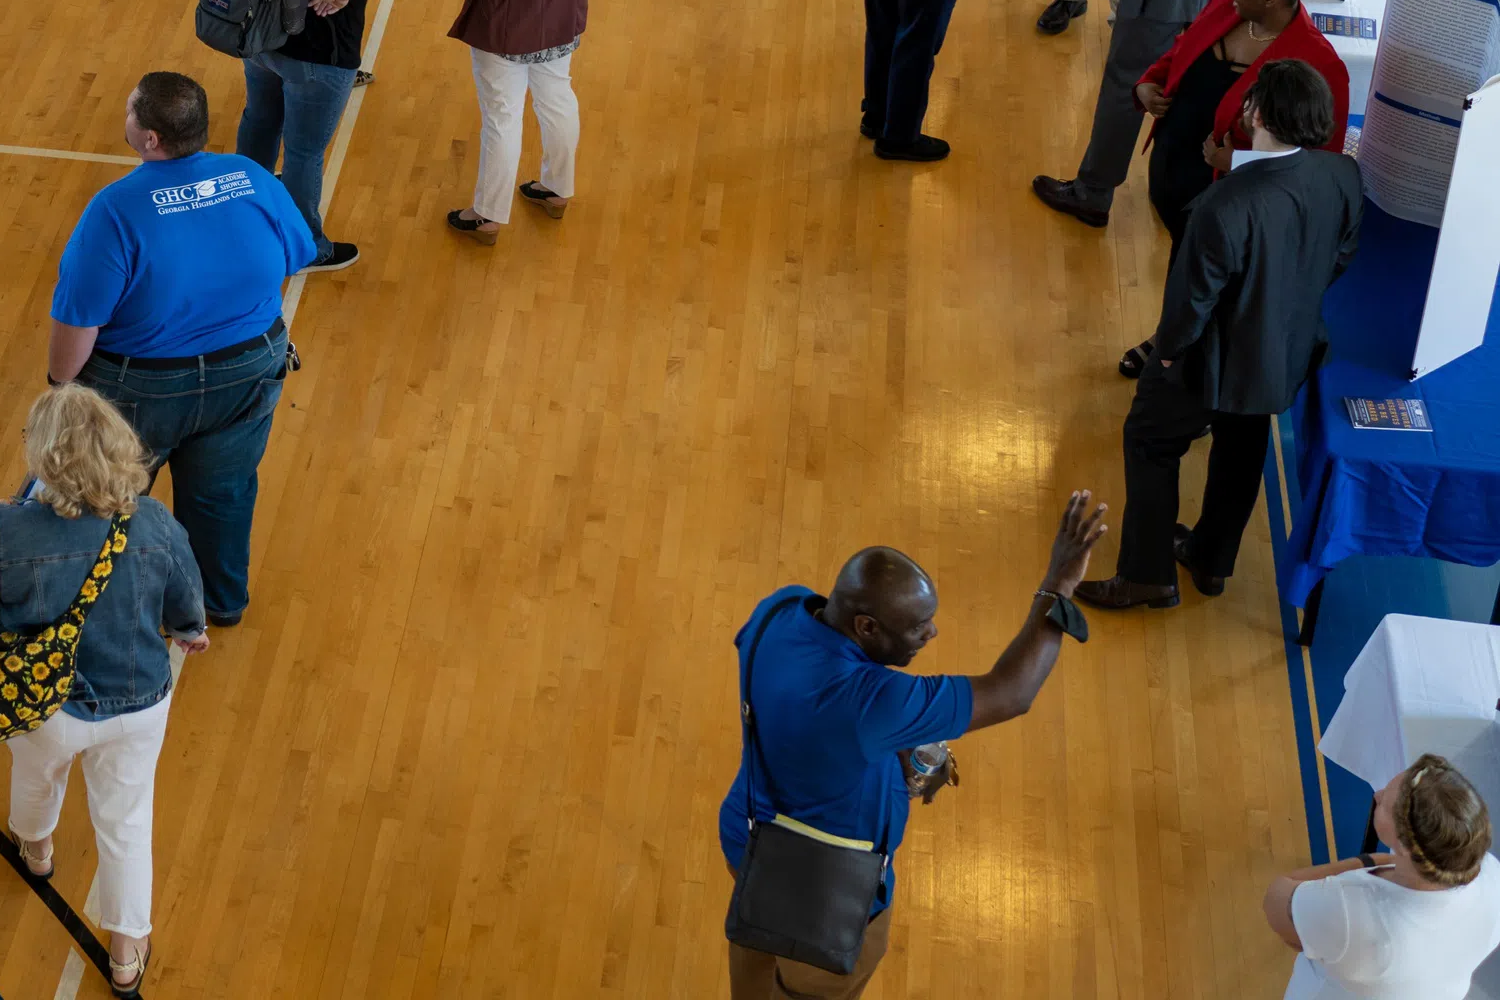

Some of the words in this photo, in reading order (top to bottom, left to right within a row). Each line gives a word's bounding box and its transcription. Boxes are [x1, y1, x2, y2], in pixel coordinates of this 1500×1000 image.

[218, 172, 248, 184] ACADEMIC
[220, 179, 251, 191] SHOWCASE
[152, 187, 194, 205] GHC
[158, 206, 190, 215] GEORGIA
[191, 195, 230, 209] HIGHLANDS
[231, 189, 255, 199] COLLEGE
[1366, 400, 1378, 421] SHARED
[1386, 399, 1400, 425] DESERVES
[1401, 412, 1412, 428] WORK
